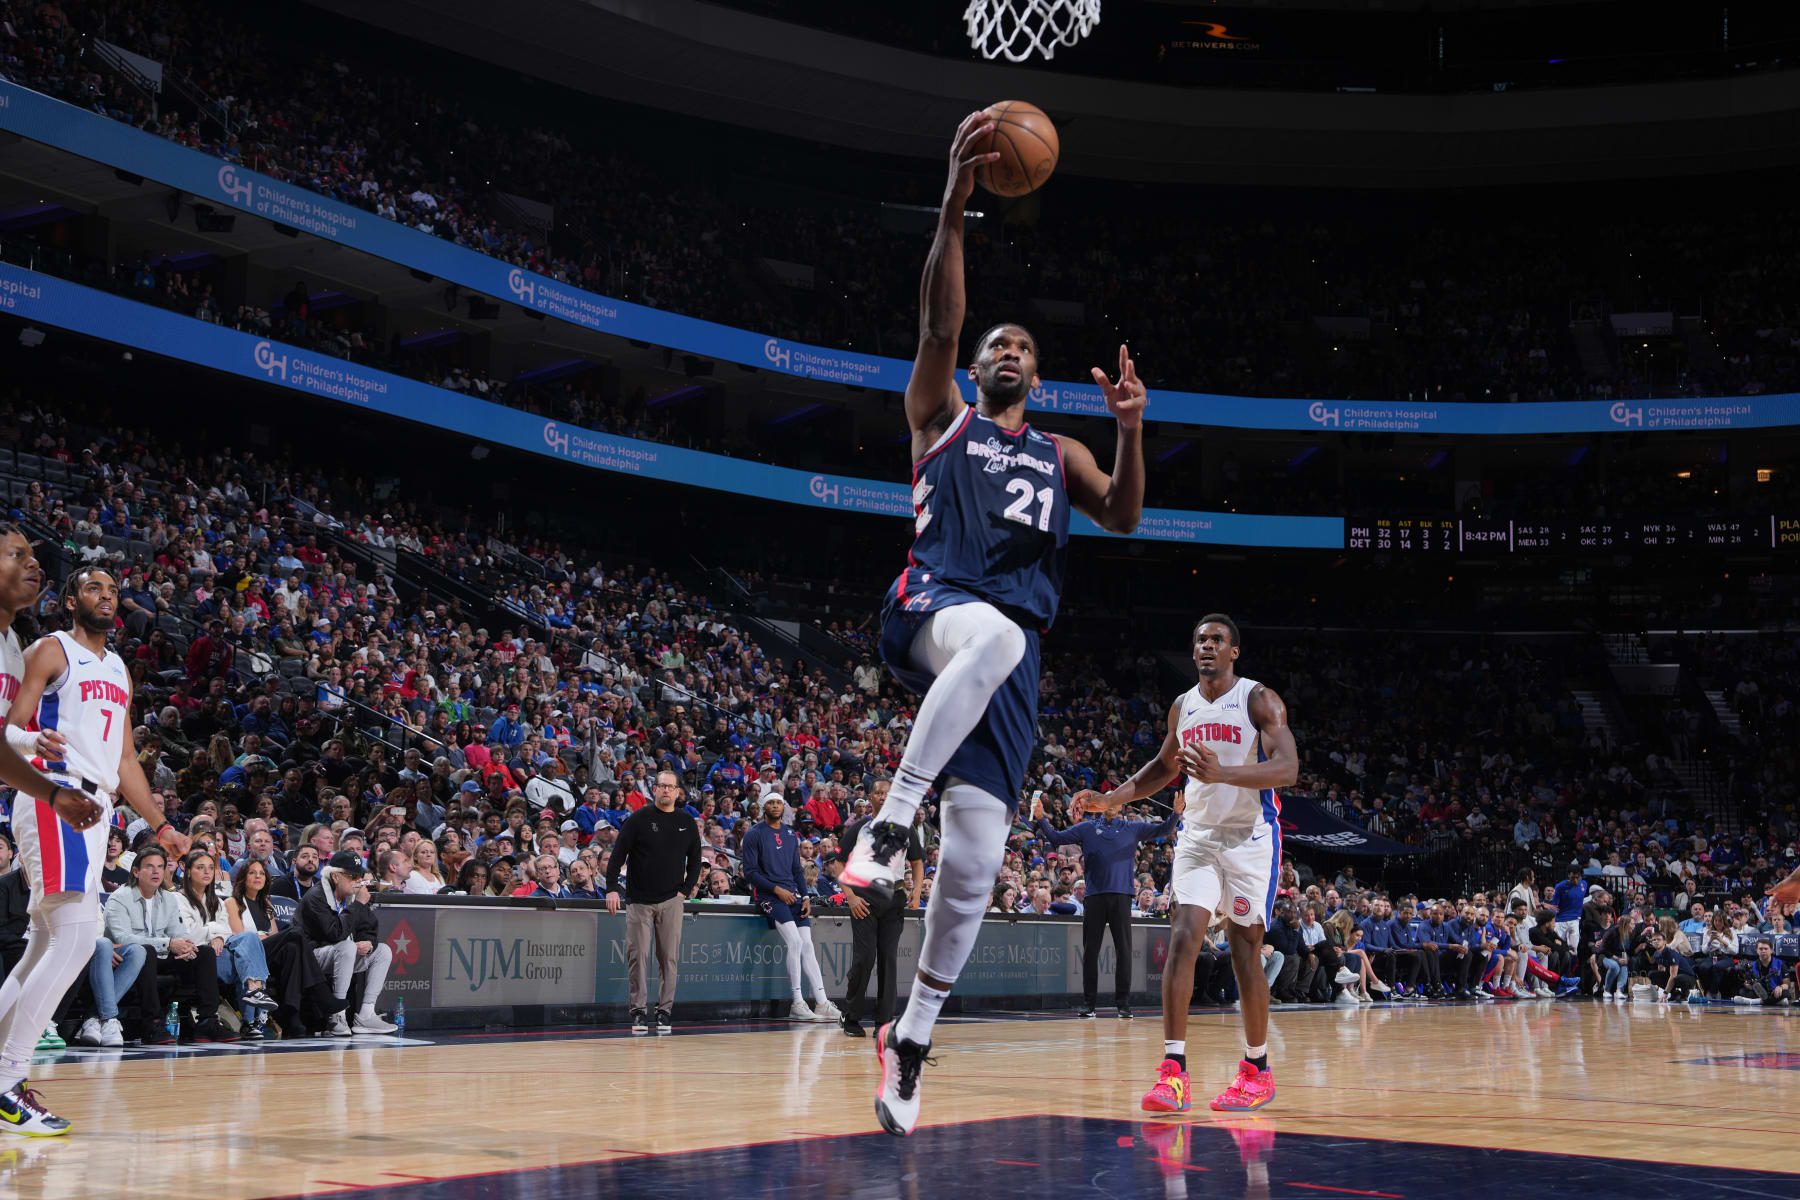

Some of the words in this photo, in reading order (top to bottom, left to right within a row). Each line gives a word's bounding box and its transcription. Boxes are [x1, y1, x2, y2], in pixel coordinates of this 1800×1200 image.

[257, 185, 310, 210] Children's
[312, 206, 356, 229] Hospital
[257, 202, 270, 213] of
[271, 206, 336, 236] Philadelphia
[537, 285, 578, 308] Children's
[579, 300, 617, 318] Hospital
[537, 300, 548, 309] of
[548, 303, 600, 327] Philadelphia
[793, 351, 838, 368] Children's
[840, 360, 881, 375] Hospital
[292, 358, 343, 383] Children's
[345, 374, 387, 393] Hospital
[793, 363, 803, 373] of
[804, 364, 864, 383] Philadelphia
[291, 374, 303, 385] of
[305, 377, 369, 402] Philadelphia
[1062, 391, 1103, 402] Children
[1075, 402, 1107, 413] Philad
[1343, 408, 1393, 420] Children's
[1394, 409, 1437, 422] Hospital
[1647, 406, 1702, 417] Children's
[1704, 405, 1751, 417] Hospital
[1343, 419, 1356, 428] of
[1357, 419, 1420, 431] Philadelphia
[1648, 417, 1660, 428] of
[1662, 416, 1731, 428] Philadelphia
[572, 435, 615, 455] Children's
[616, 447, 657, 464] Hospital
[571, 450, 581, 459] of
[582, 451, 640, 471] Philadelphia
[966, 441, 1056, 476] BROTHERLY
[842, 485, 889, 502] Children's
[890, 492, 912, 507] Hosp
[842, 497, 853, 507] of
[854, 498, 913, 515] Philadelphia
[1004, 478, 1054, 532] 21
[1172, 518, 1212, 530] Hospital
[1398, 520, 1411, 528] AST
[1420, 521, 1432, 529] BLK
[1441, 521, 1453, 529] STL
[1518, 526, 1533, 535] SAS
[1580, 526, 1596, 534] SAC
[1643, 524, 1660, 533] NYK
[1707, 523, 1727, 532] WAS
[1730, 523, 1740, 531] 47
[1137, 526, 1196, 540] Philadelphia
[1351, 527, 1369, 537] PHI
[1378, 528, 1391, 538] 32
[1400, 529, 1410, 538] 17
[1423, 529, 1429, 539] 3
[1443, 530, 1450, 539] 7
[1465, 531, 1487, 541] 8:42
[1490, 531, 1506, 541] PM
[1643, 537, 1658, 545] CHI
[1666, 537, 1676, 545] 27
[1708, 536, 1725, 544] MIN
[1350, 538, 1371, 549] DET
[1377, 539, 1391, 549] 30
[1400, 539, 1411, 549] 14
[1423, 540, 1429, 550] 3
[1444, 541, 1450, 550] 2
[1518, 538, 1536, 547] MEM
[1539, 538, 1550, 547] 33
[1580, 538, 1596, 546] OKC
[79, 680, 129, 709] PISTON
[101, 708, 112, 742] 7
[1182, 722, 1242, 748] PISTONS
[526, 940, 585, 957] Insurance
[726, 941, 788, 965] MASCOT
[968, 946, 996, 964] GLES
[1007, 945, 1061, 965] MASCOTS
[445, 938, 526, 992] NJM
[820, 942, 853, 986] NJ
[525, 962, 563, 984] Group
[684, 974, 709, 983] GREAT
[711, 974, 755, 983] INSURANCE
[381, 980, 430, 991] KERSTARS
